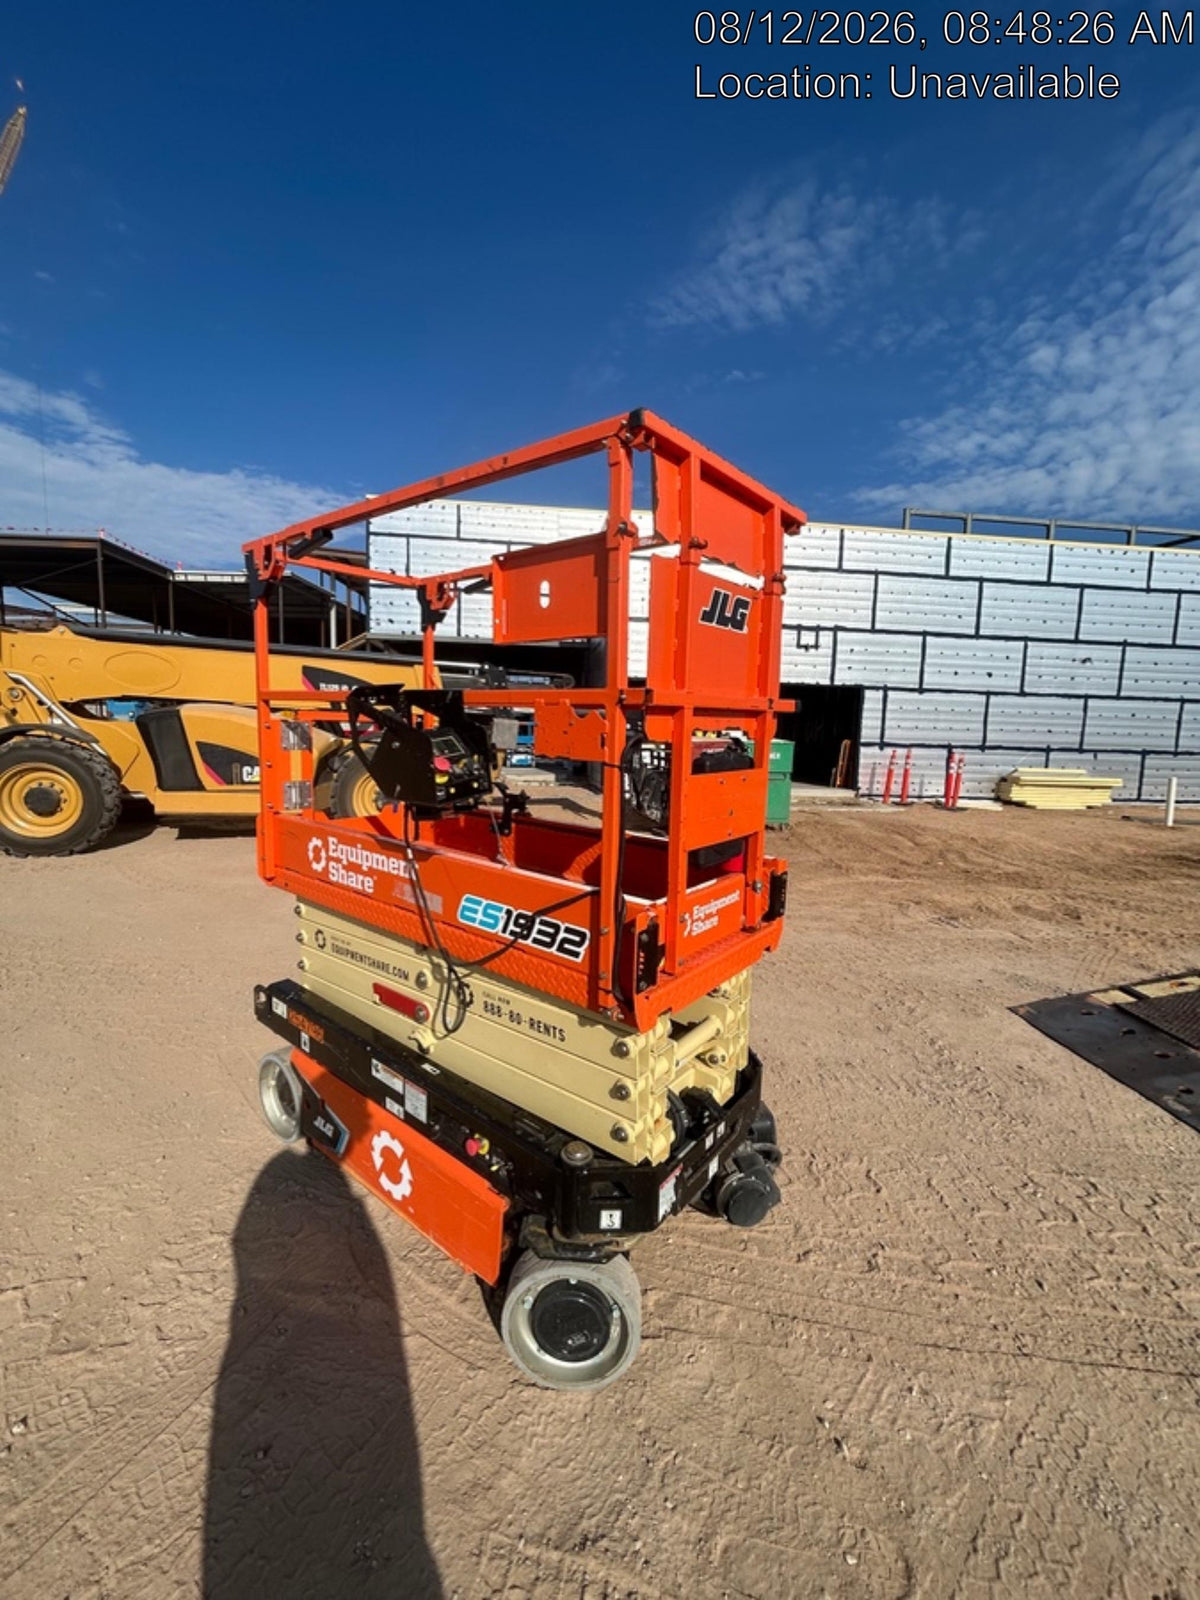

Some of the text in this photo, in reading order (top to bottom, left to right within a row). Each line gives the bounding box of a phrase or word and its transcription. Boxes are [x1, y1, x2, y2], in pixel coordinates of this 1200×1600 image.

[698, 587, 752, 634] JLG
[242, 765, 260, 782] CA
[328, 861, 375, 893] Share
[693, 889, 740, 919] Equipment
[457, 894, 590, 962] ES1932
[692, 915, 719, 936] Share
